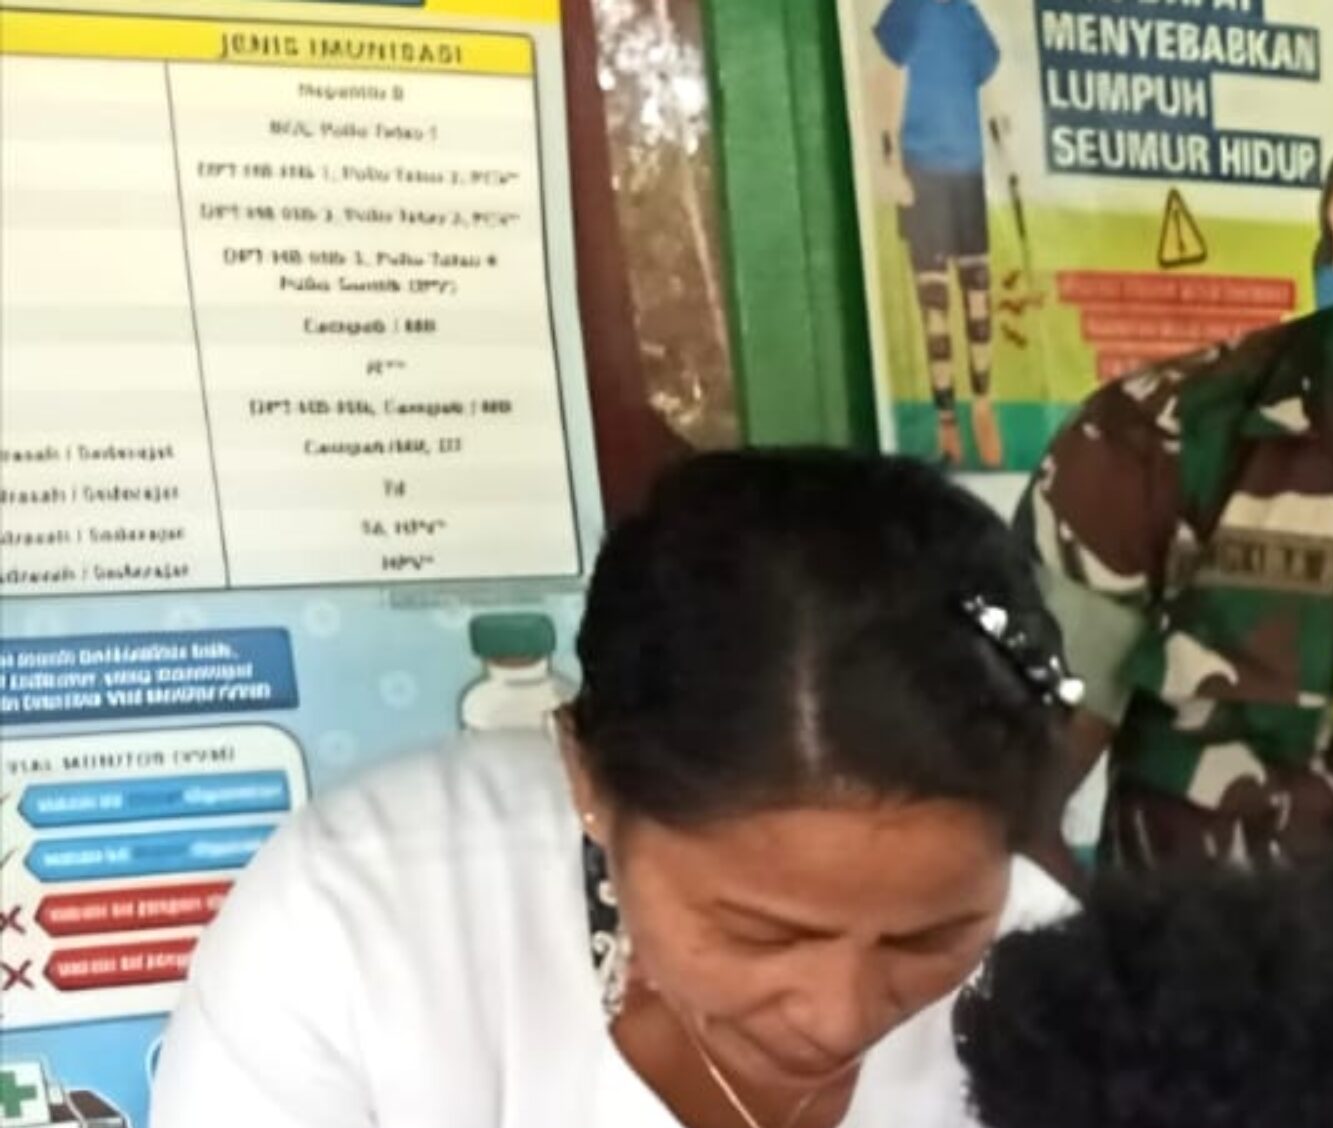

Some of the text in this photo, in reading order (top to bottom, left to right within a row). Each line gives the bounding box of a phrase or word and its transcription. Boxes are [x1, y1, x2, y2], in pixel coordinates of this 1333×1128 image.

[219, 31, 463, 65] JENIS IMUNISASI
[1041, 11, 1317, 72] MENYEBABKAN
[1046, 69, 1207, 119] LUMPUH
[1051, 126, 1317, 181] SEUMUR HIDUP
